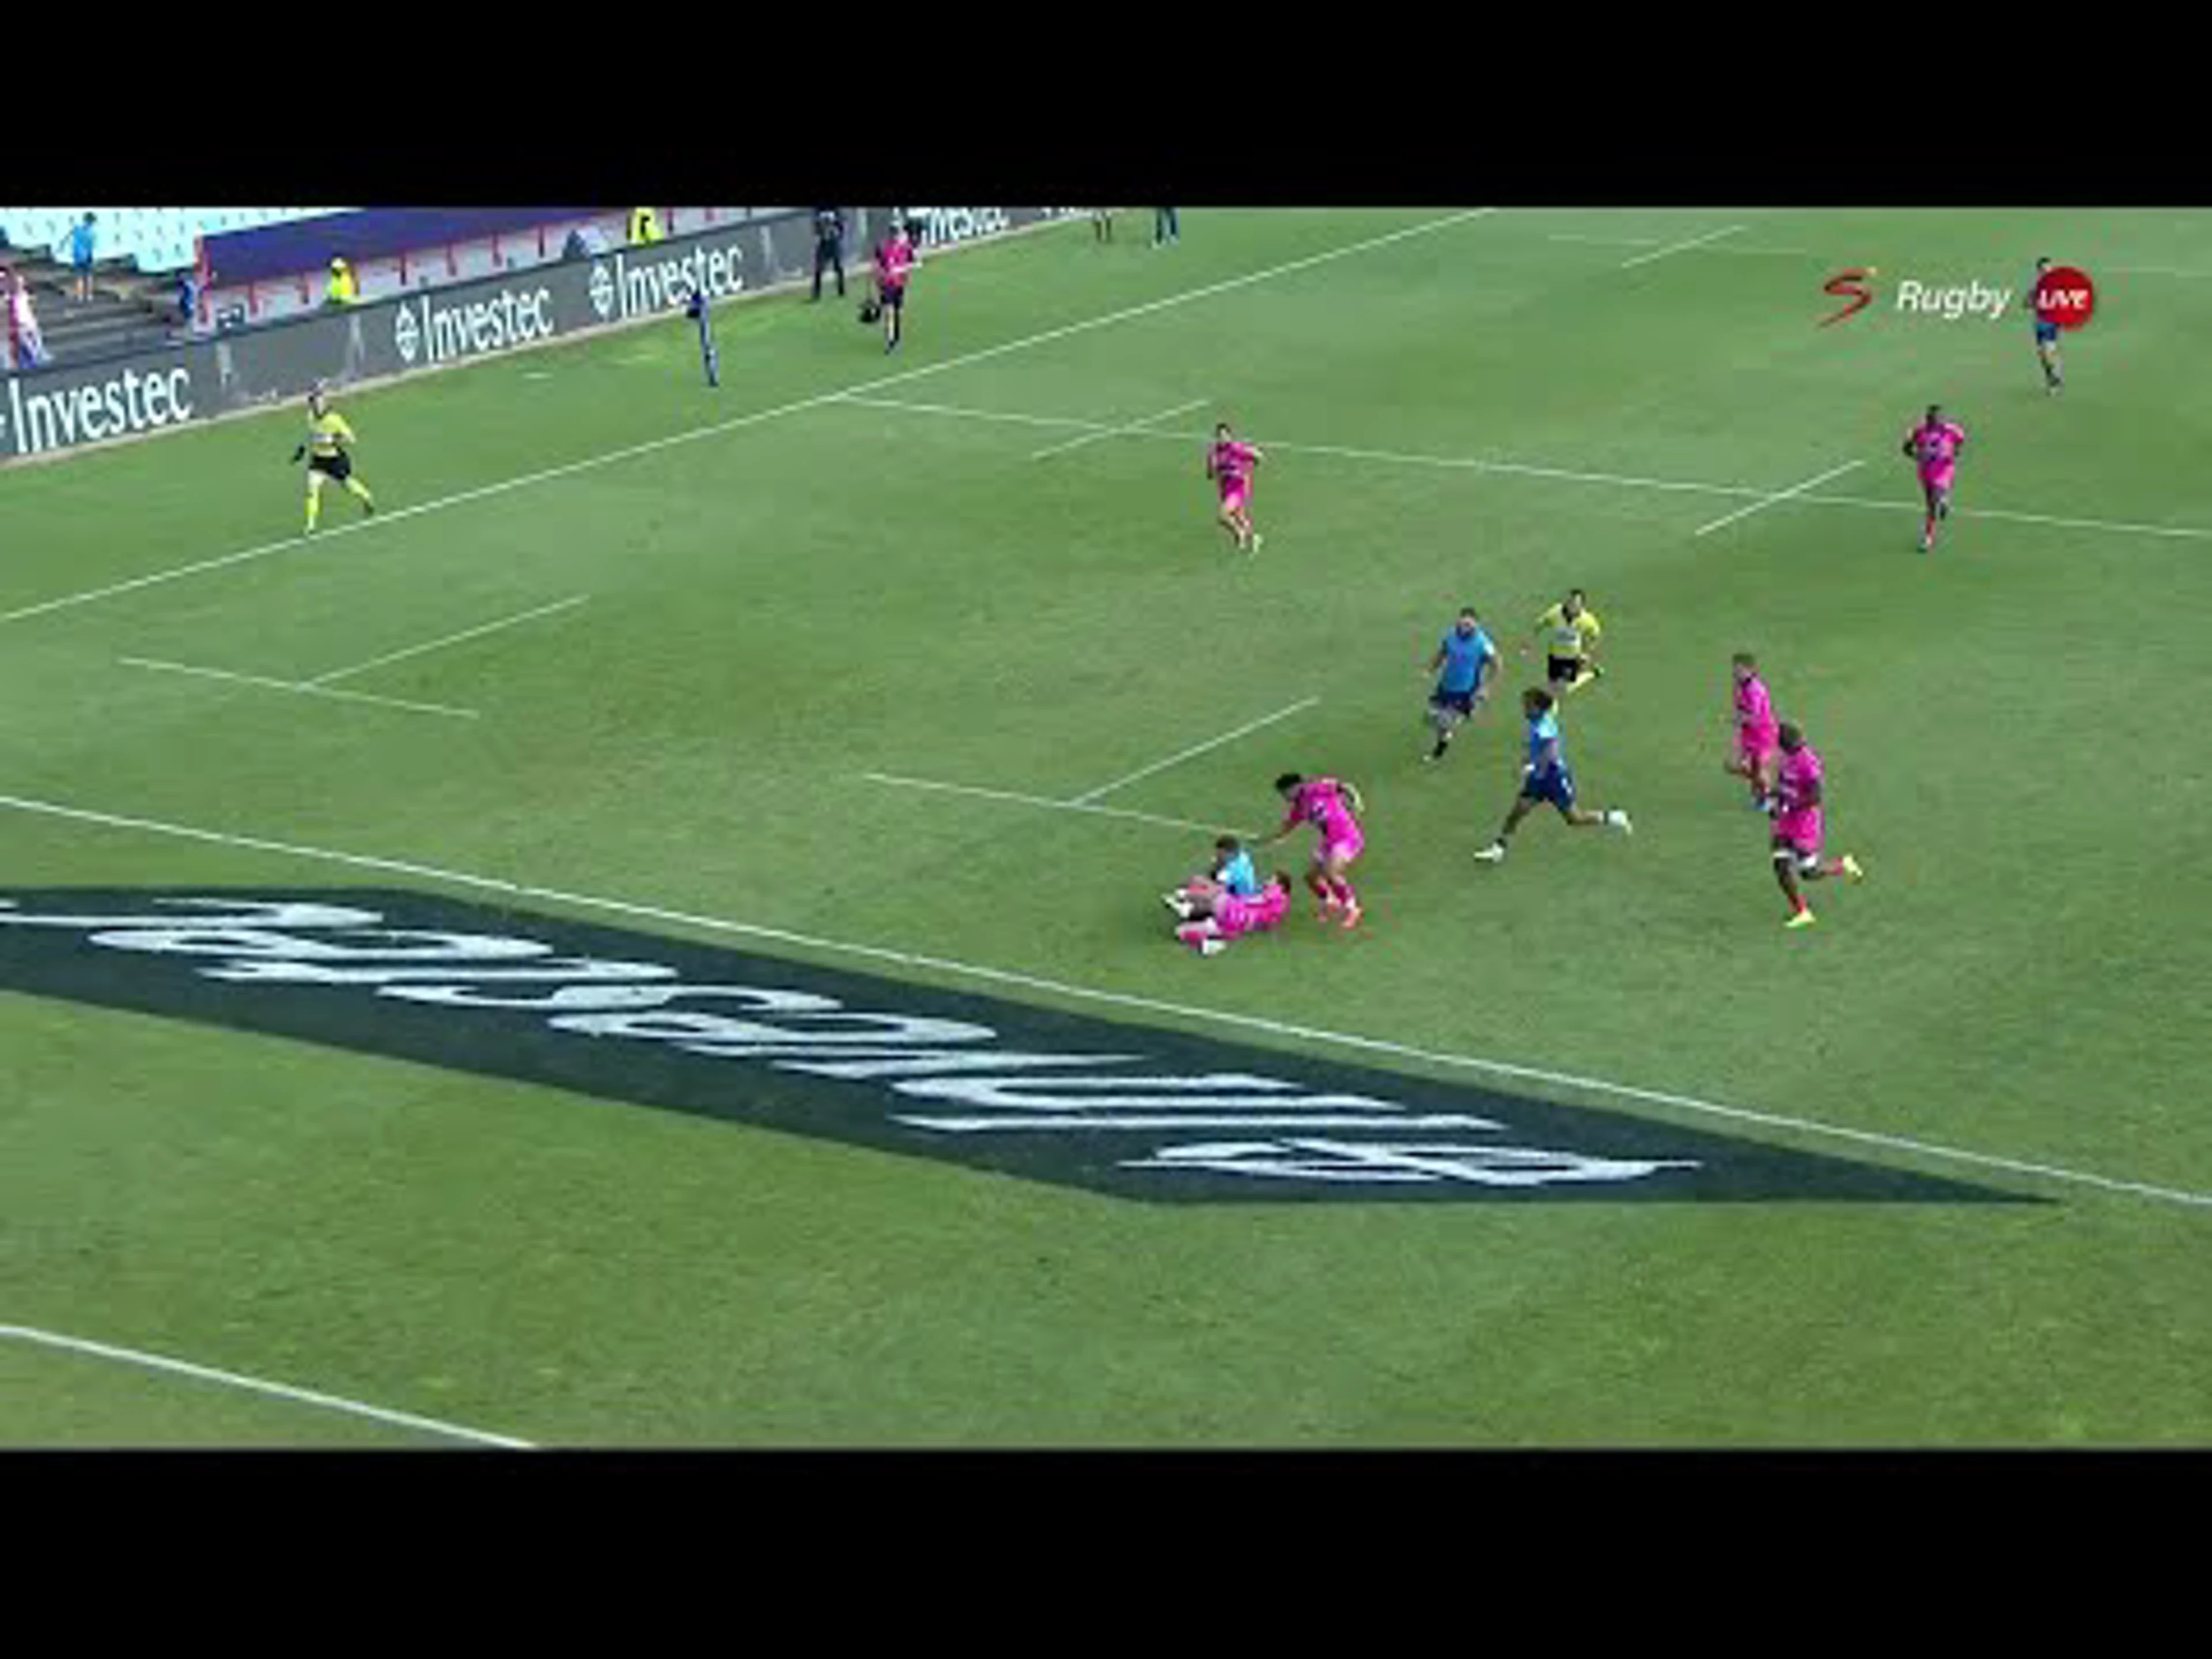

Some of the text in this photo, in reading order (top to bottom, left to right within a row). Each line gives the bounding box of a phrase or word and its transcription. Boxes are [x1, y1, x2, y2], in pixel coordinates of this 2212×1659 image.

[616, 244, 743, 319] Investec
[421, 286, 554, 362] Investec
[8, 368, 194, 454] Investec
